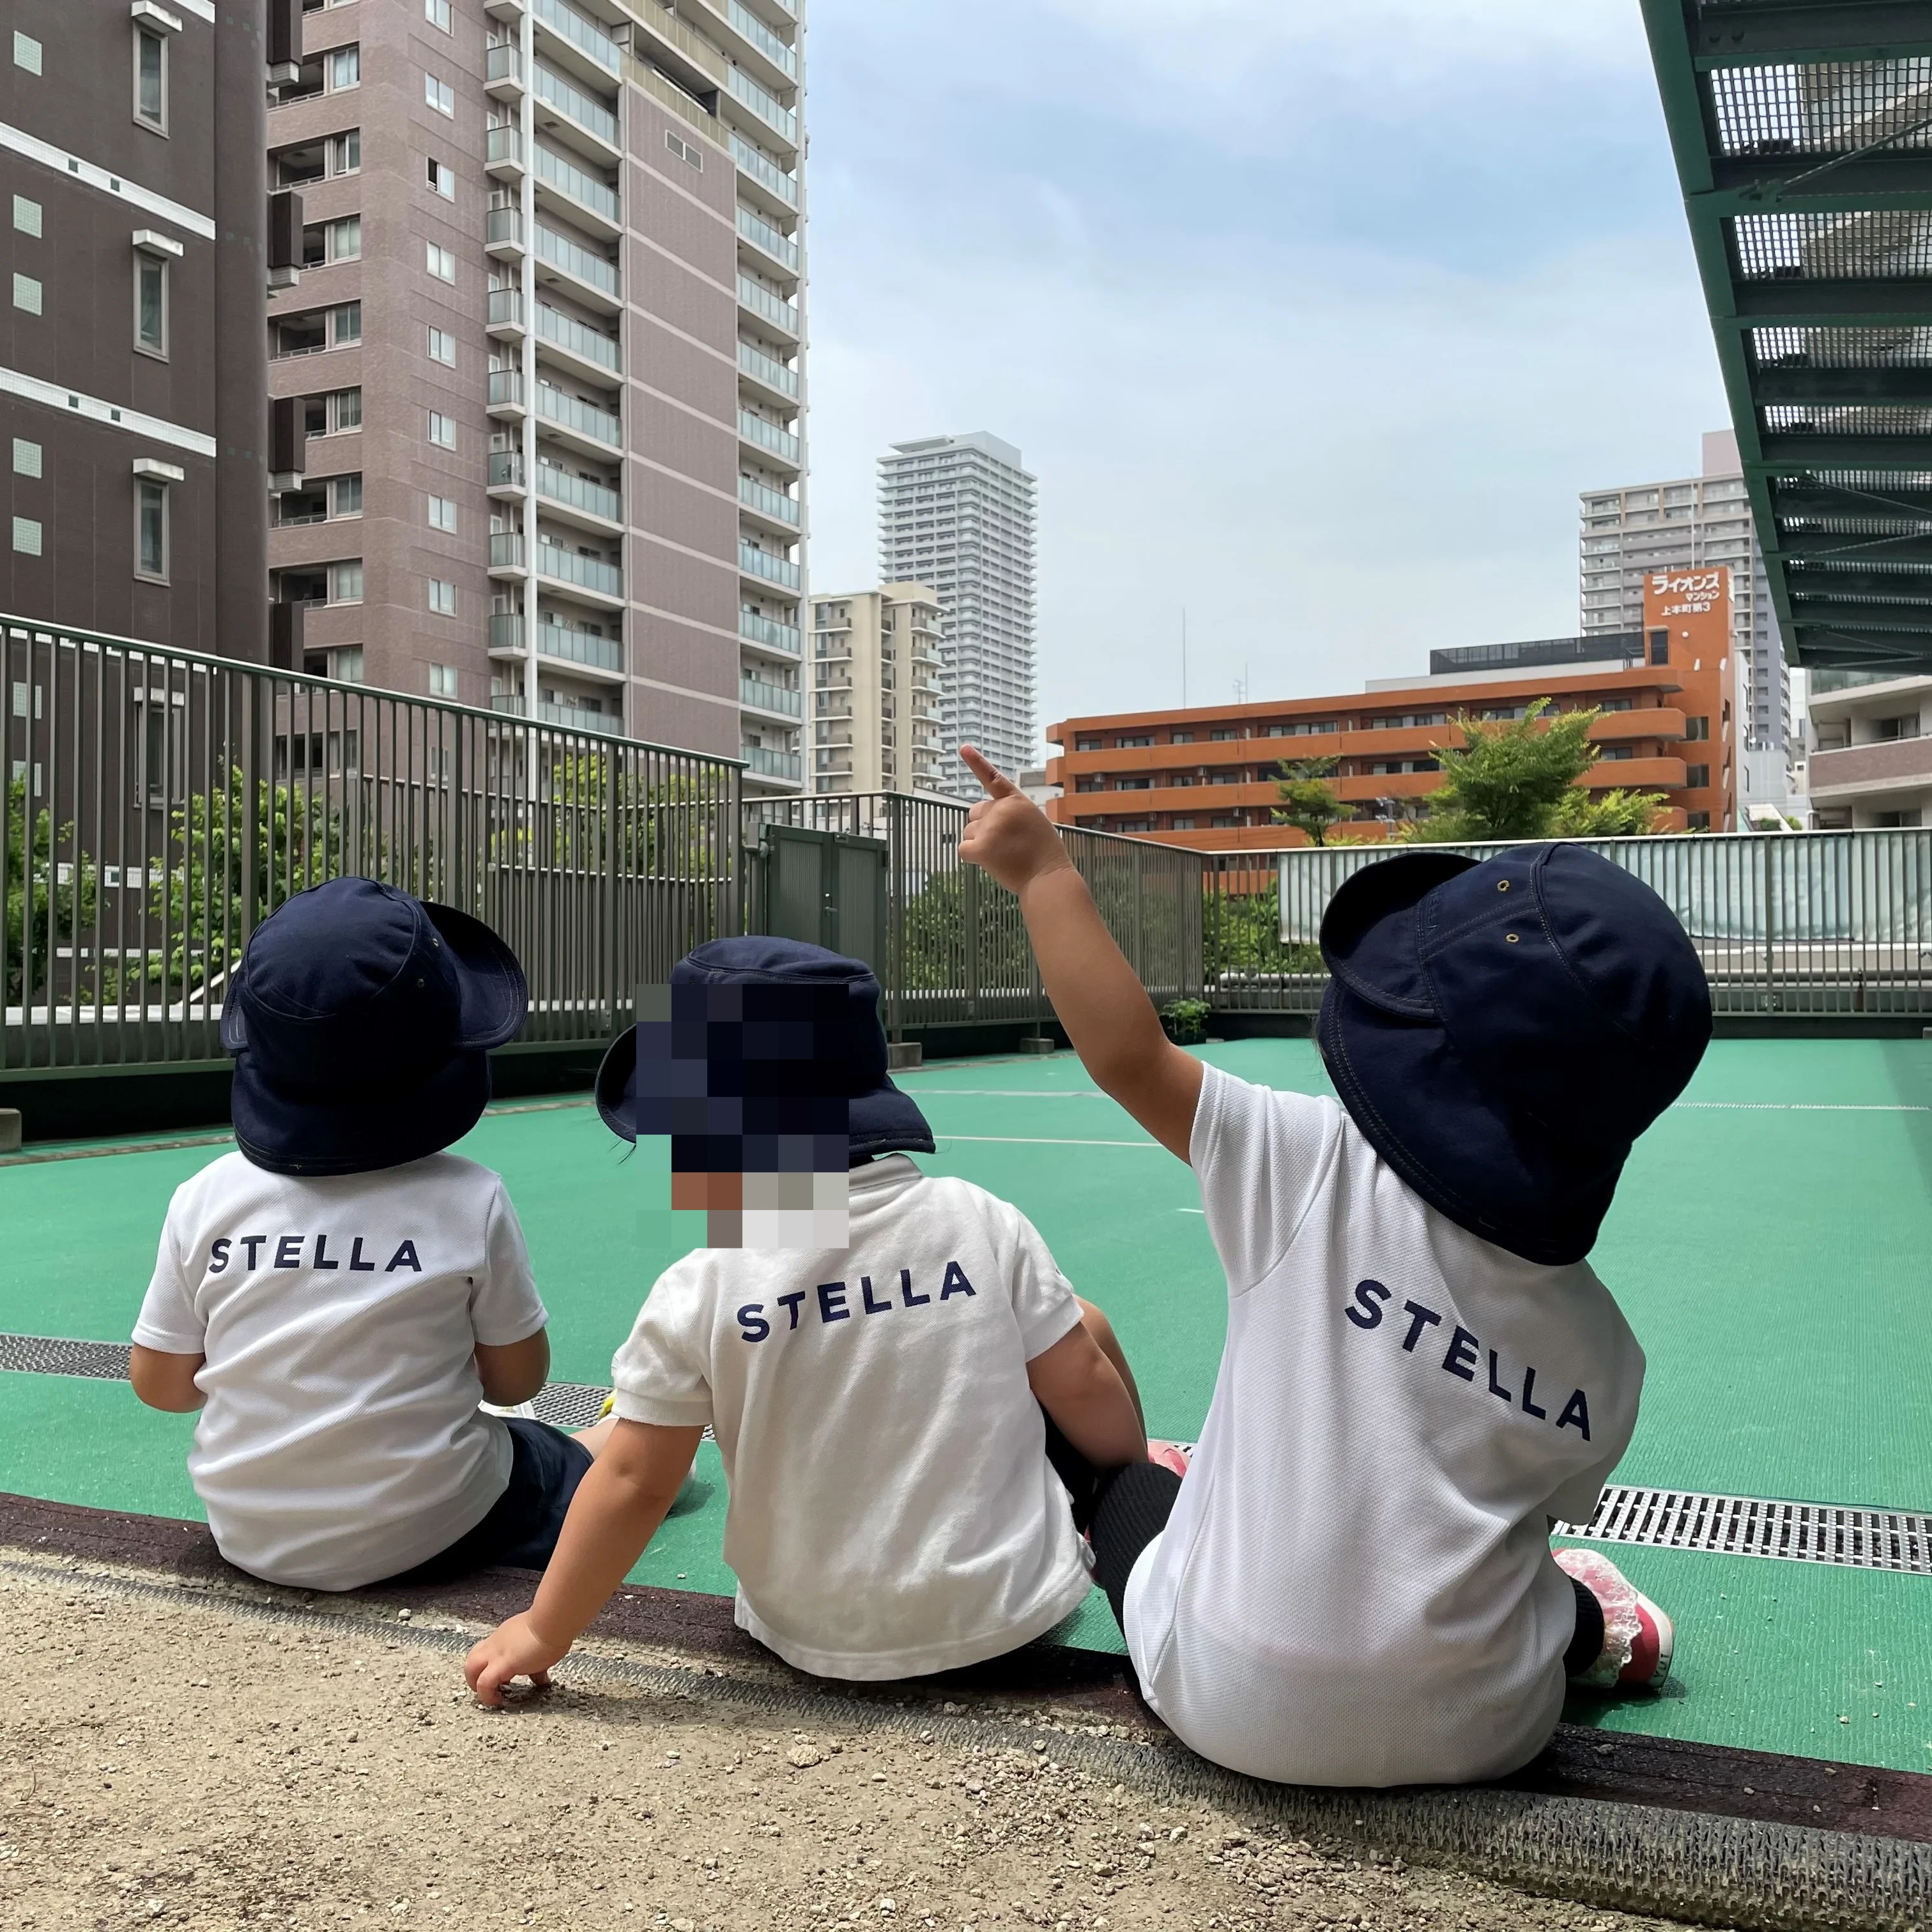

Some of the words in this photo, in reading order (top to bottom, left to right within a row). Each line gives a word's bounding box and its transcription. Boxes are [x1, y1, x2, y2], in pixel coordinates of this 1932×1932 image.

[1652, 571, 1721, 595] ライオンズ
[209, 1234, 422, 1274] STELLA
[736, 1260, 977, 1344] STELLA
[1344, 1278, 1591, 1442] STELLA
